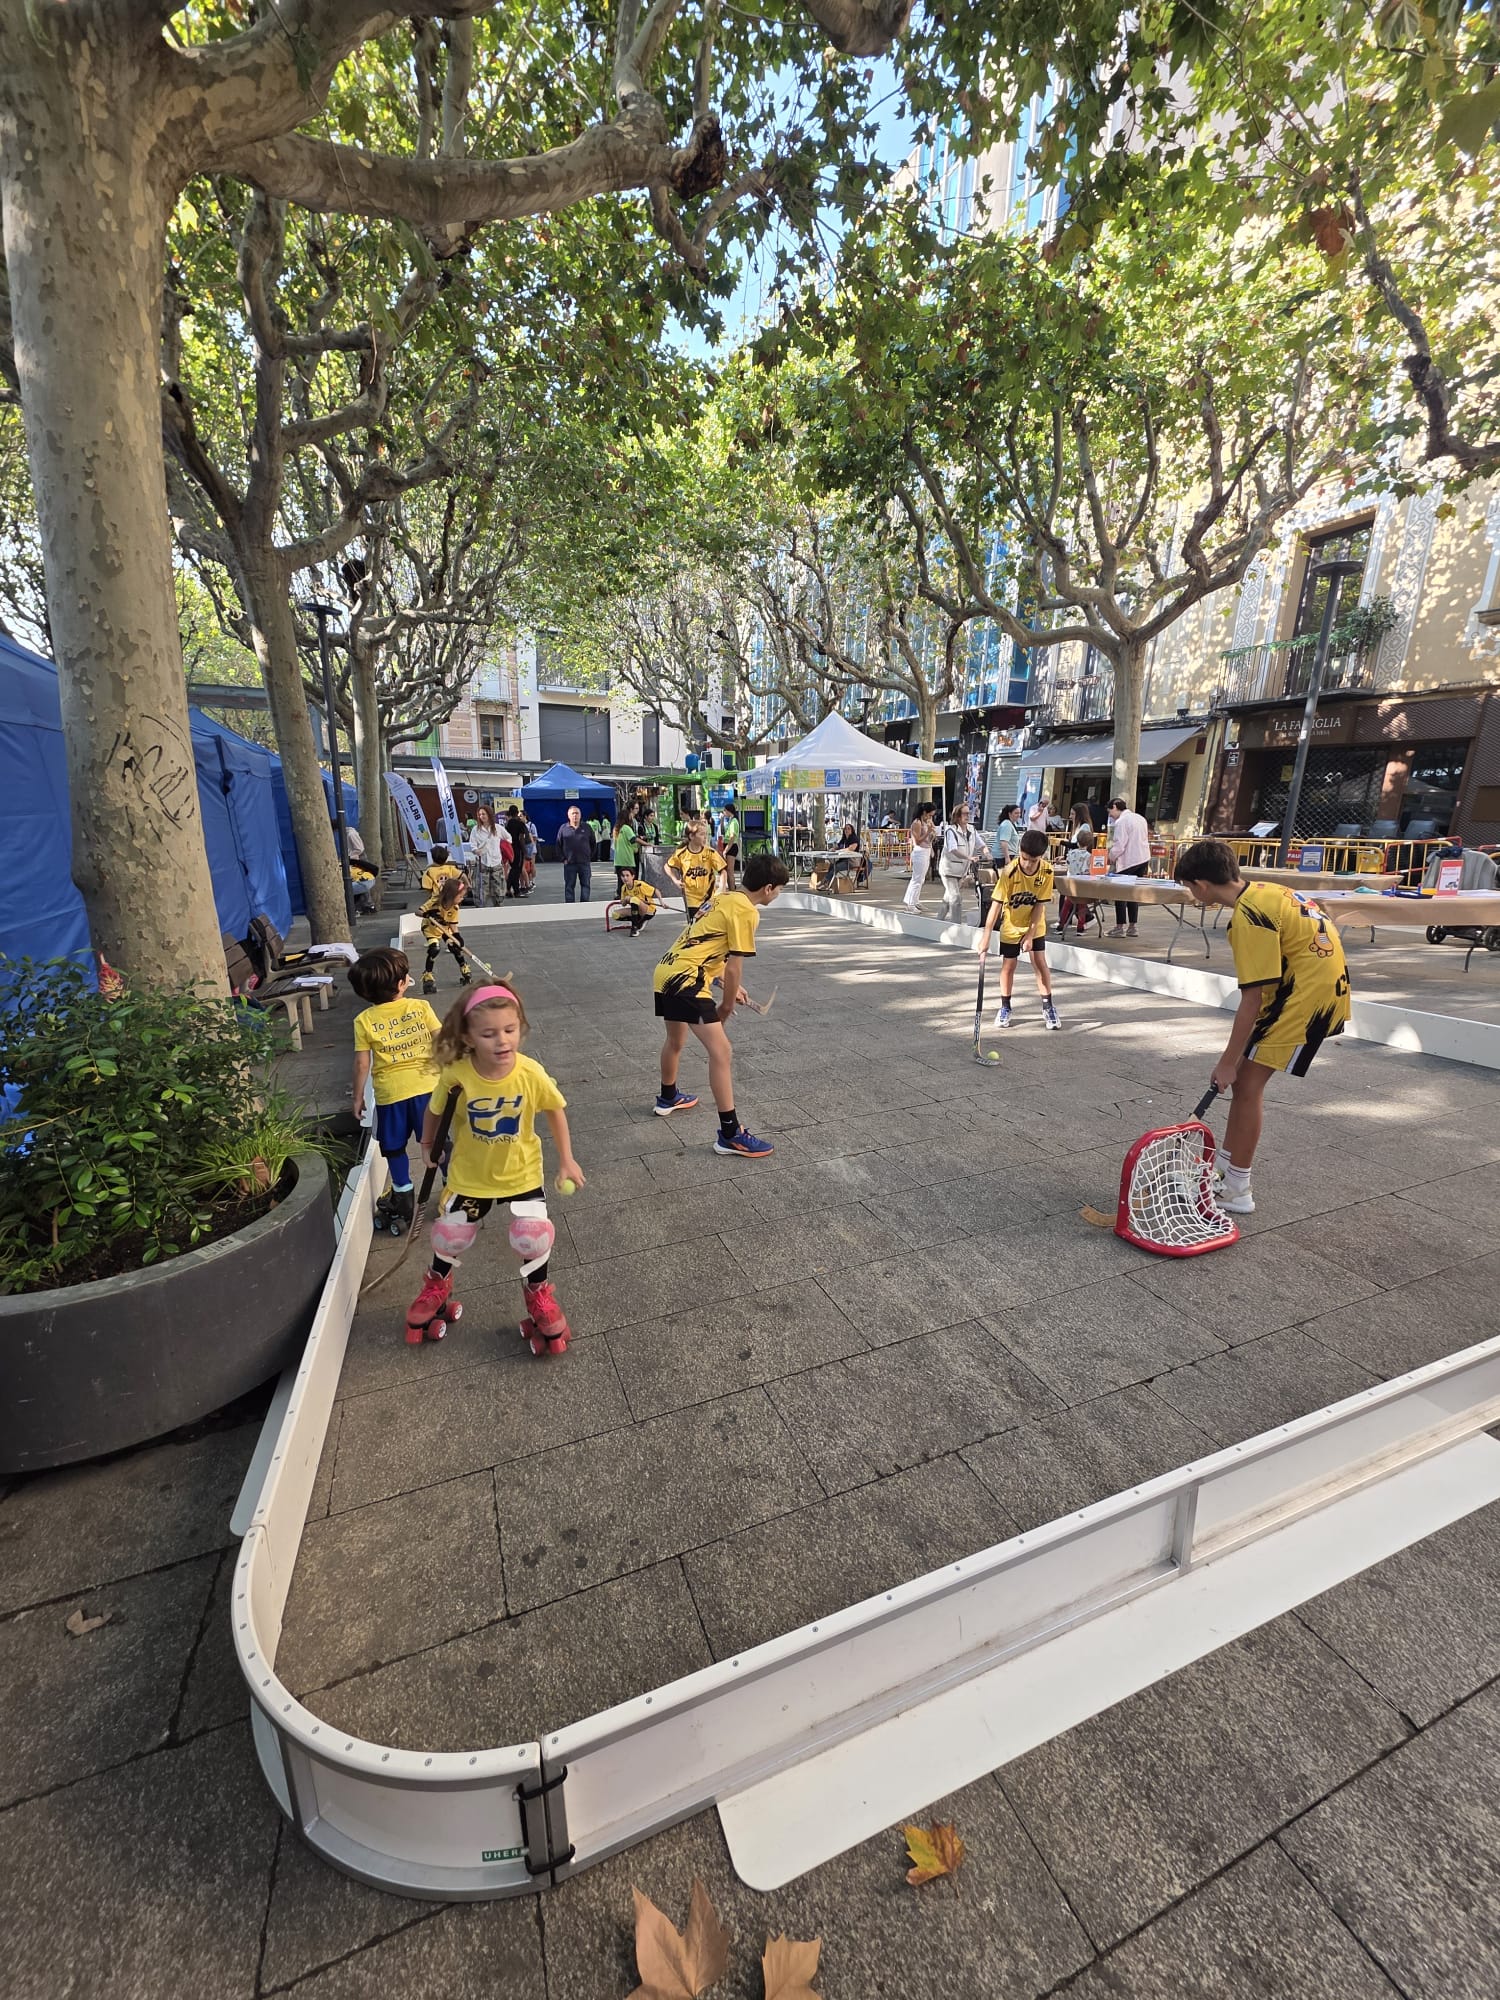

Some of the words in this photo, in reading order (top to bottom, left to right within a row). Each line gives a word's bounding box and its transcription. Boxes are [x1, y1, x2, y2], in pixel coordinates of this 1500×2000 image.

[1274, 721, 1288, 731] LA
[1289, 717, 1342, 730] FAIGLIA
[372, 1023, 385, 1032] Jo
[388, 1018, 399, 1030] ja
[467, 1095, 523, 1111] CH
